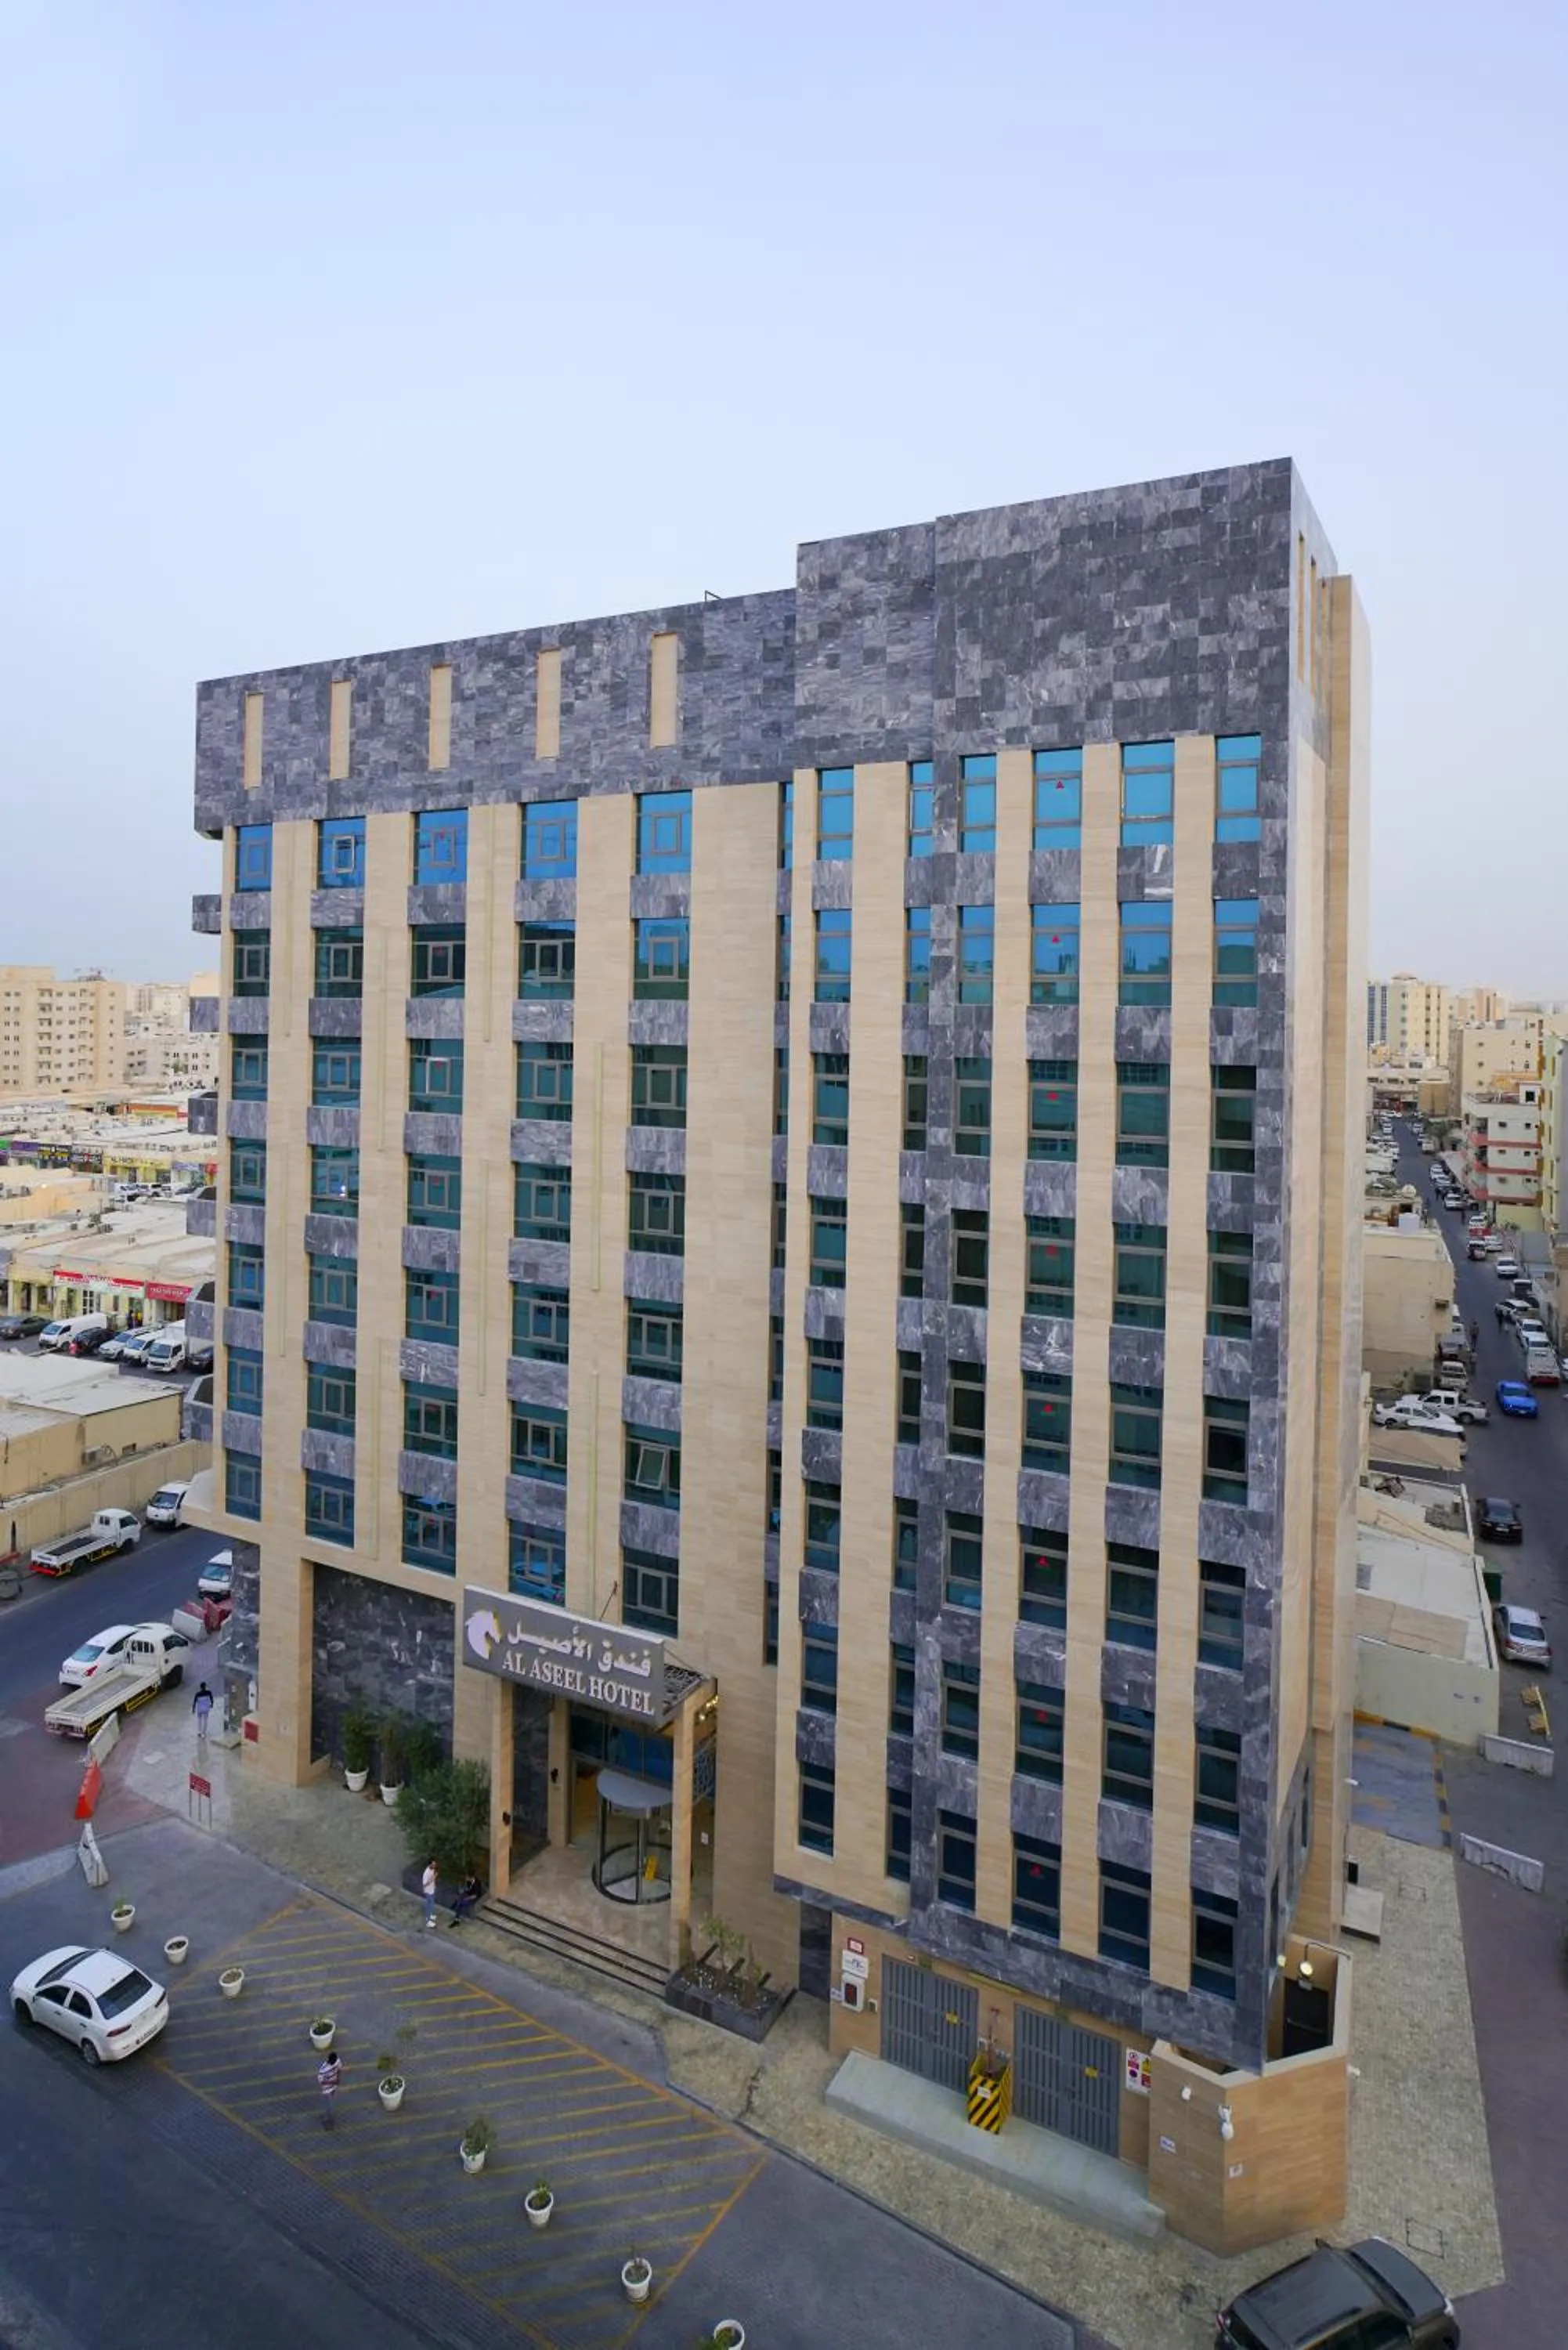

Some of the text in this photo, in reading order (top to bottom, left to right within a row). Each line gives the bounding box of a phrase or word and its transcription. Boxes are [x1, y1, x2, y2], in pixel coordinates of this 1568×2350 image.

[503, 1650, 654, 1715] AL ASEEL HOTEL
[598, 1640, 652, 1676] فندق
